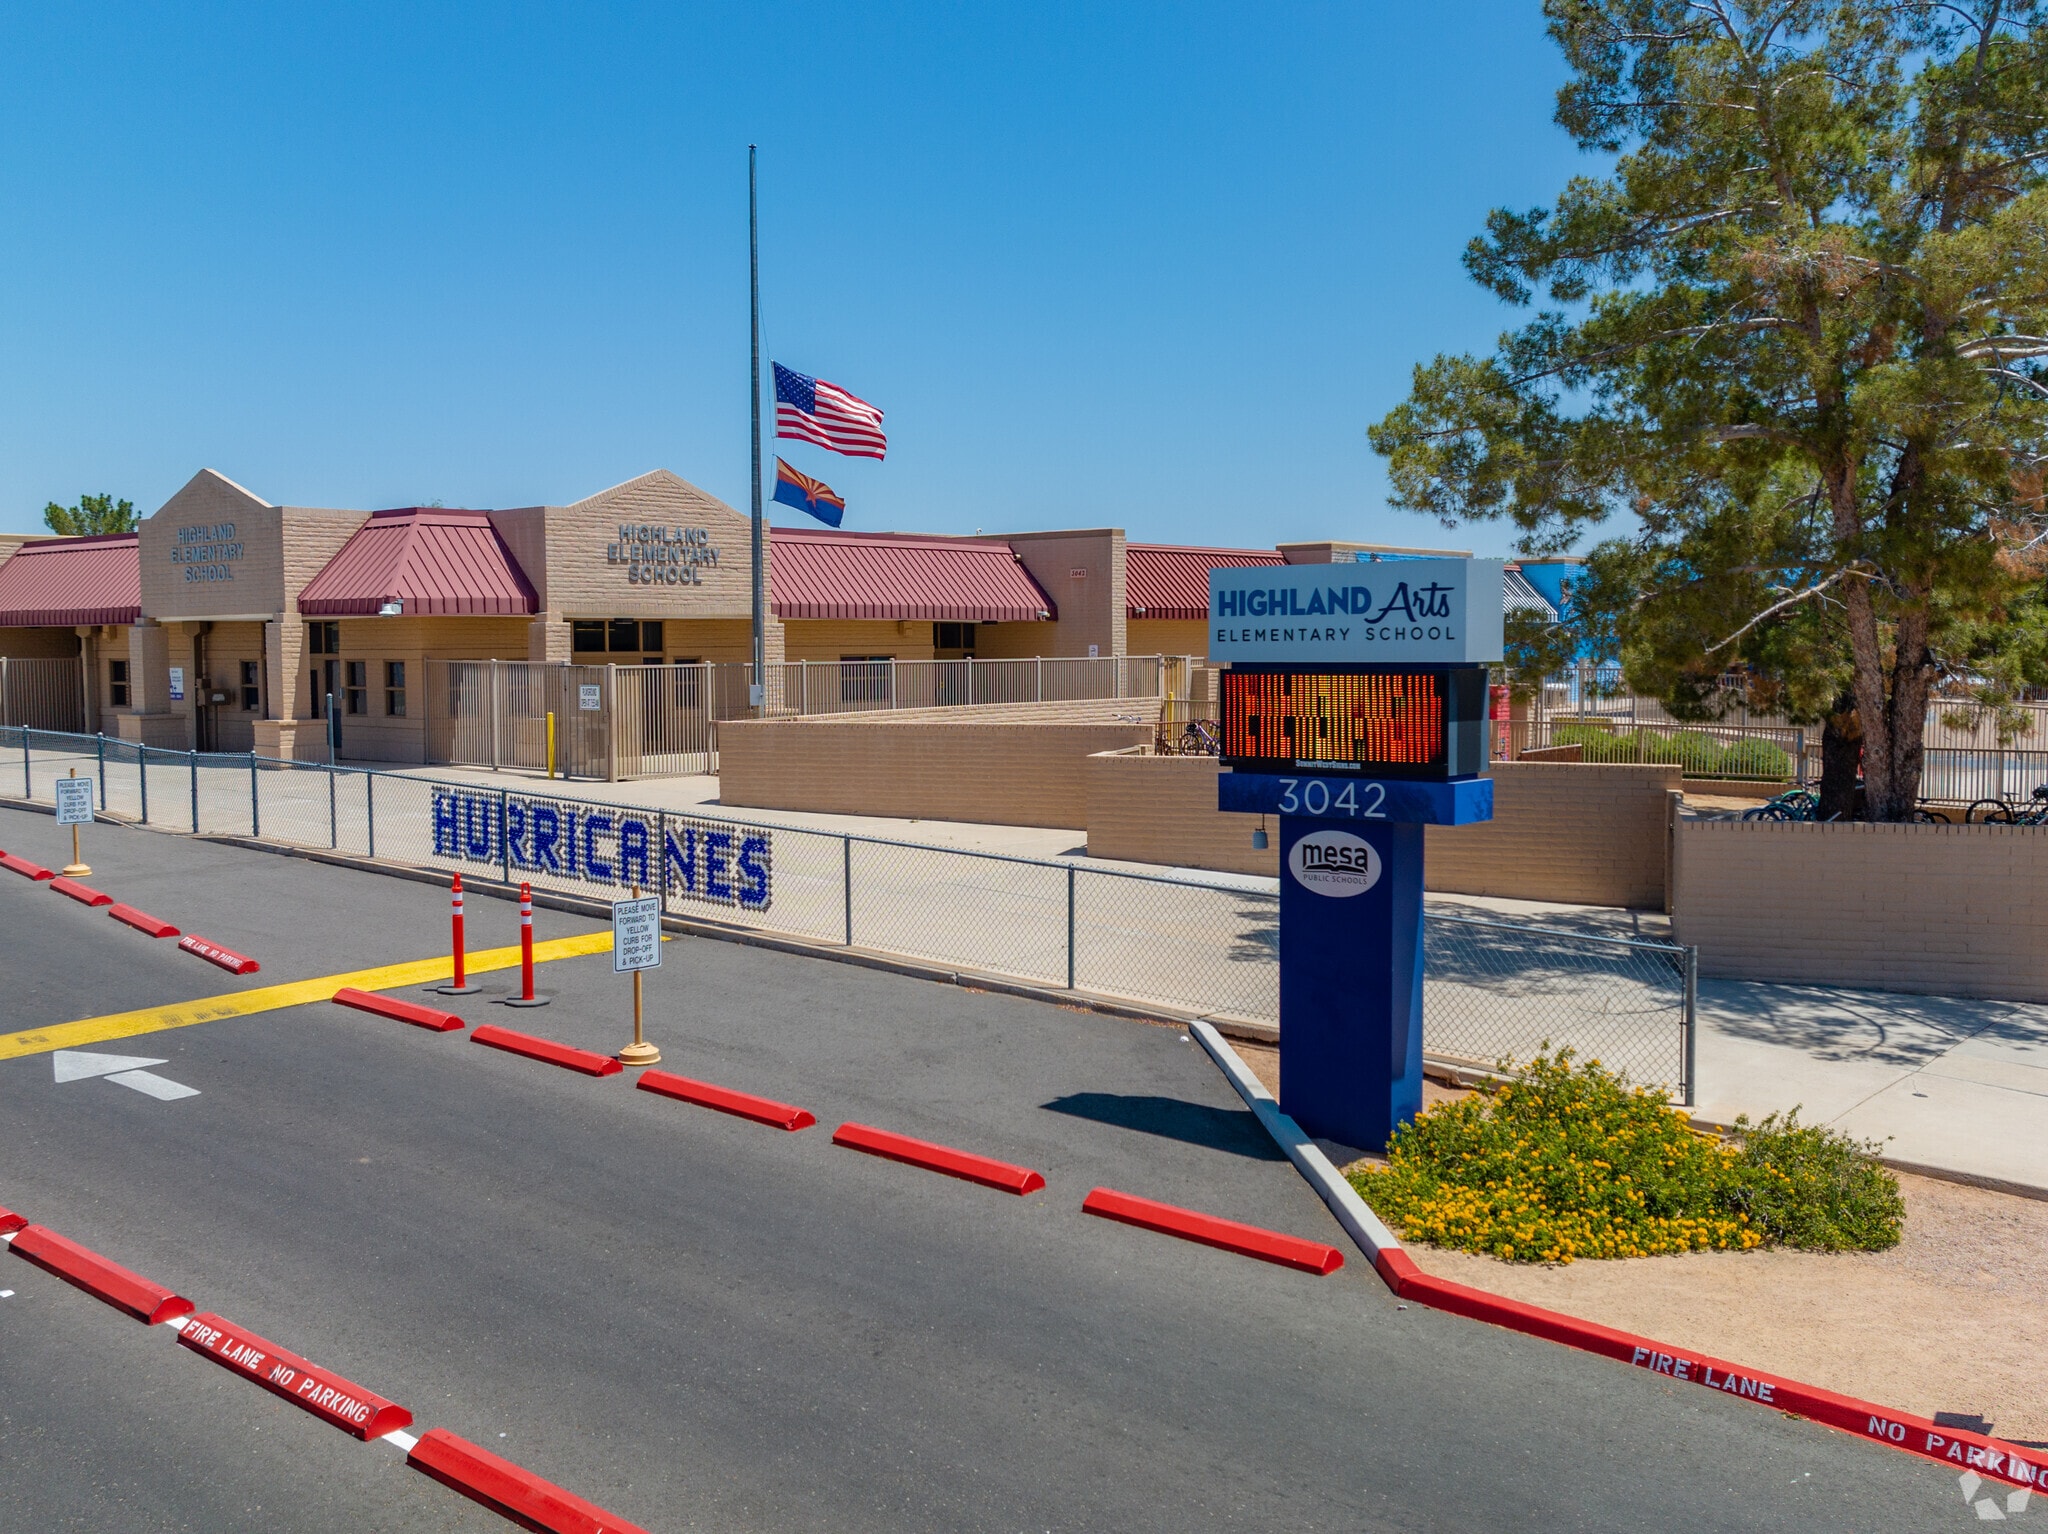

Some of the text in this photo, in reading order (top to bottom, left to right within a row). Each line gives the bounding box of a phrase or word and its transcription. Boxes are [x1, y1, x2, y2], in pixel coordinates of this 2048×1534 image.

[177, 523, 236, 545] HIGHLAND
[618, 524, 709, 545] HIGHLAND
[170, 542, 244, 564] ELEMENTARY
[607, 543, 720, 564] ELEMENTARY
[184, 564, 234, 583] SCHOOL
[628, 563, 703, 584] SCHOOL
[1218, 581, 1455, 625] HIGHLAND Arts
[1217, 627, 1456, 642] ELEMENTARY SCHOOL
[1278, 779, 1386, 818] 3042
[432, 788, 771, 909] HURRICANES
[1302, 843, 1368, 871] mesa
[1303, 873, 1368, 885] PUBLIC SCHOOLS
[617, 903, 656, 915] PLEASE MOVE
[619, 913, 655, 925] FORWARD TO
[623, 934, 652, 945] CURB FOR
[626, 925, 649, 934] YELLOW
[181, 936, 243, 967] FIRE LANE NO PARKING
[623, 944, 652, 955] DROP-OFF
[629, 954, 654, 964] PICK-UP
[183, 1320, 371, 1423] FIRE LANE NO PARKING
[1632, 1346, 1692, 1380] FIRE
[1705, 1366, 1776, 1403] LANE
[1867, 1415, 1906, 1442] NO
